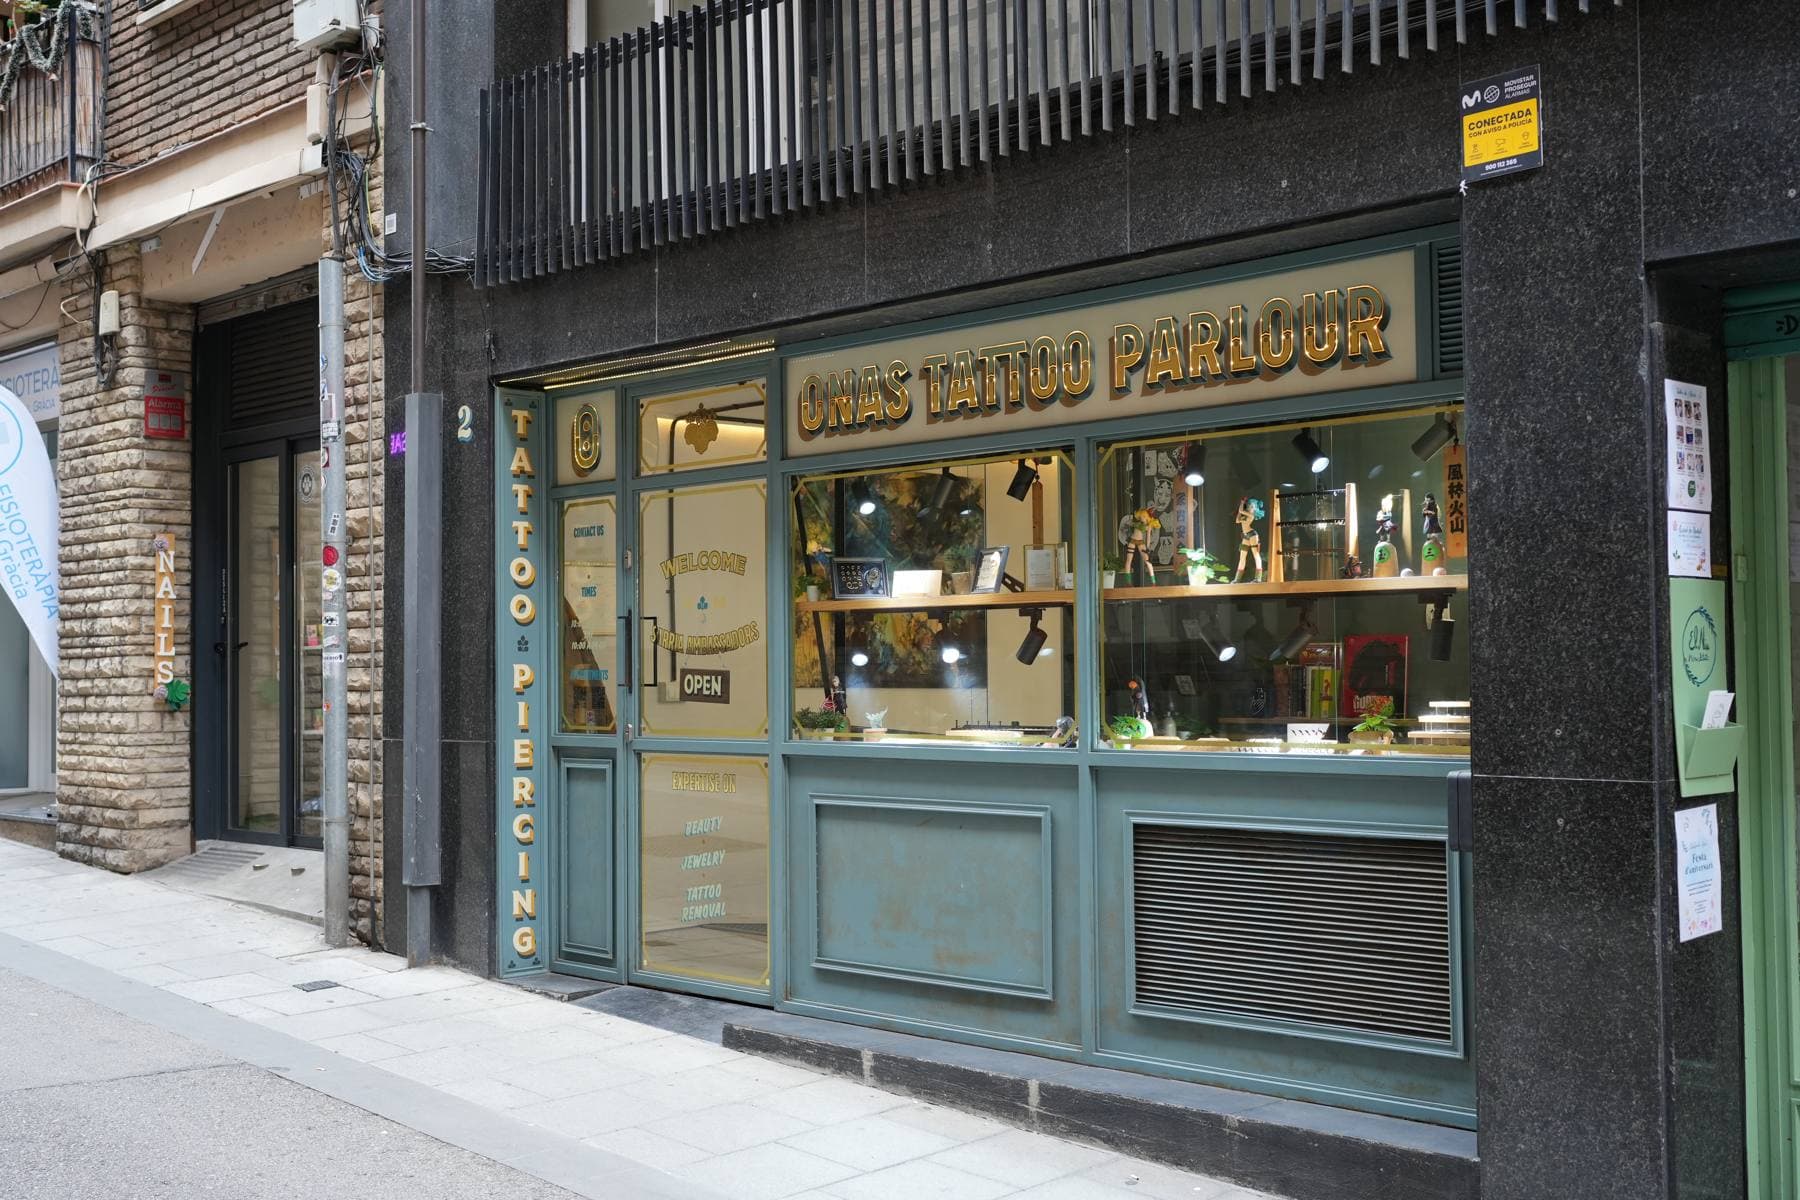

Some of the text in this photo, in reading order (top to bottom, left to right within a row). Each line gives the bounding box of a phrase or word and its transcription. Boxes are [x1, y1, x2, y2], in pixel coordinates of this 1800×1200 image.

[1504, 75, 1534, 87] MOVISTAR
[1504, 80, 1537, 94] PROSEGUR
[1504, 88, 1531, 99] ALARMAS
[1468, 108, 1532, 131] CONECTADA
[1468, 130, 1482, 138] CON
[1483, 125, 1501, 135] AVISO
[799, 283, 1391, 434] ONAS TATTOO PARLOUR
[458, 405, 474, 443] 2
[510, 409, 536, 625] TATTOO
[573, 525, 604, 539] CONTACT US
[0, 484, 58, 619] FISIOTERÀPIA
[659, 550, 748, 580] WELCOME
[581, 586, 597, 598] TIMES
[157, 550, 176, 684] NAILS
[683, 673, 723, 697] OPEN
[672, 771, 737, 794] EXPERTISE ON
[511, 663, 537, 958] PIERCING
[683, 815, 723, 838] BEAUTY
[680, 850, 726, 872] JEWELRY
[686, 883, 722, 903] TATTOO
[680, 902, 727, 924] REMOVAL
